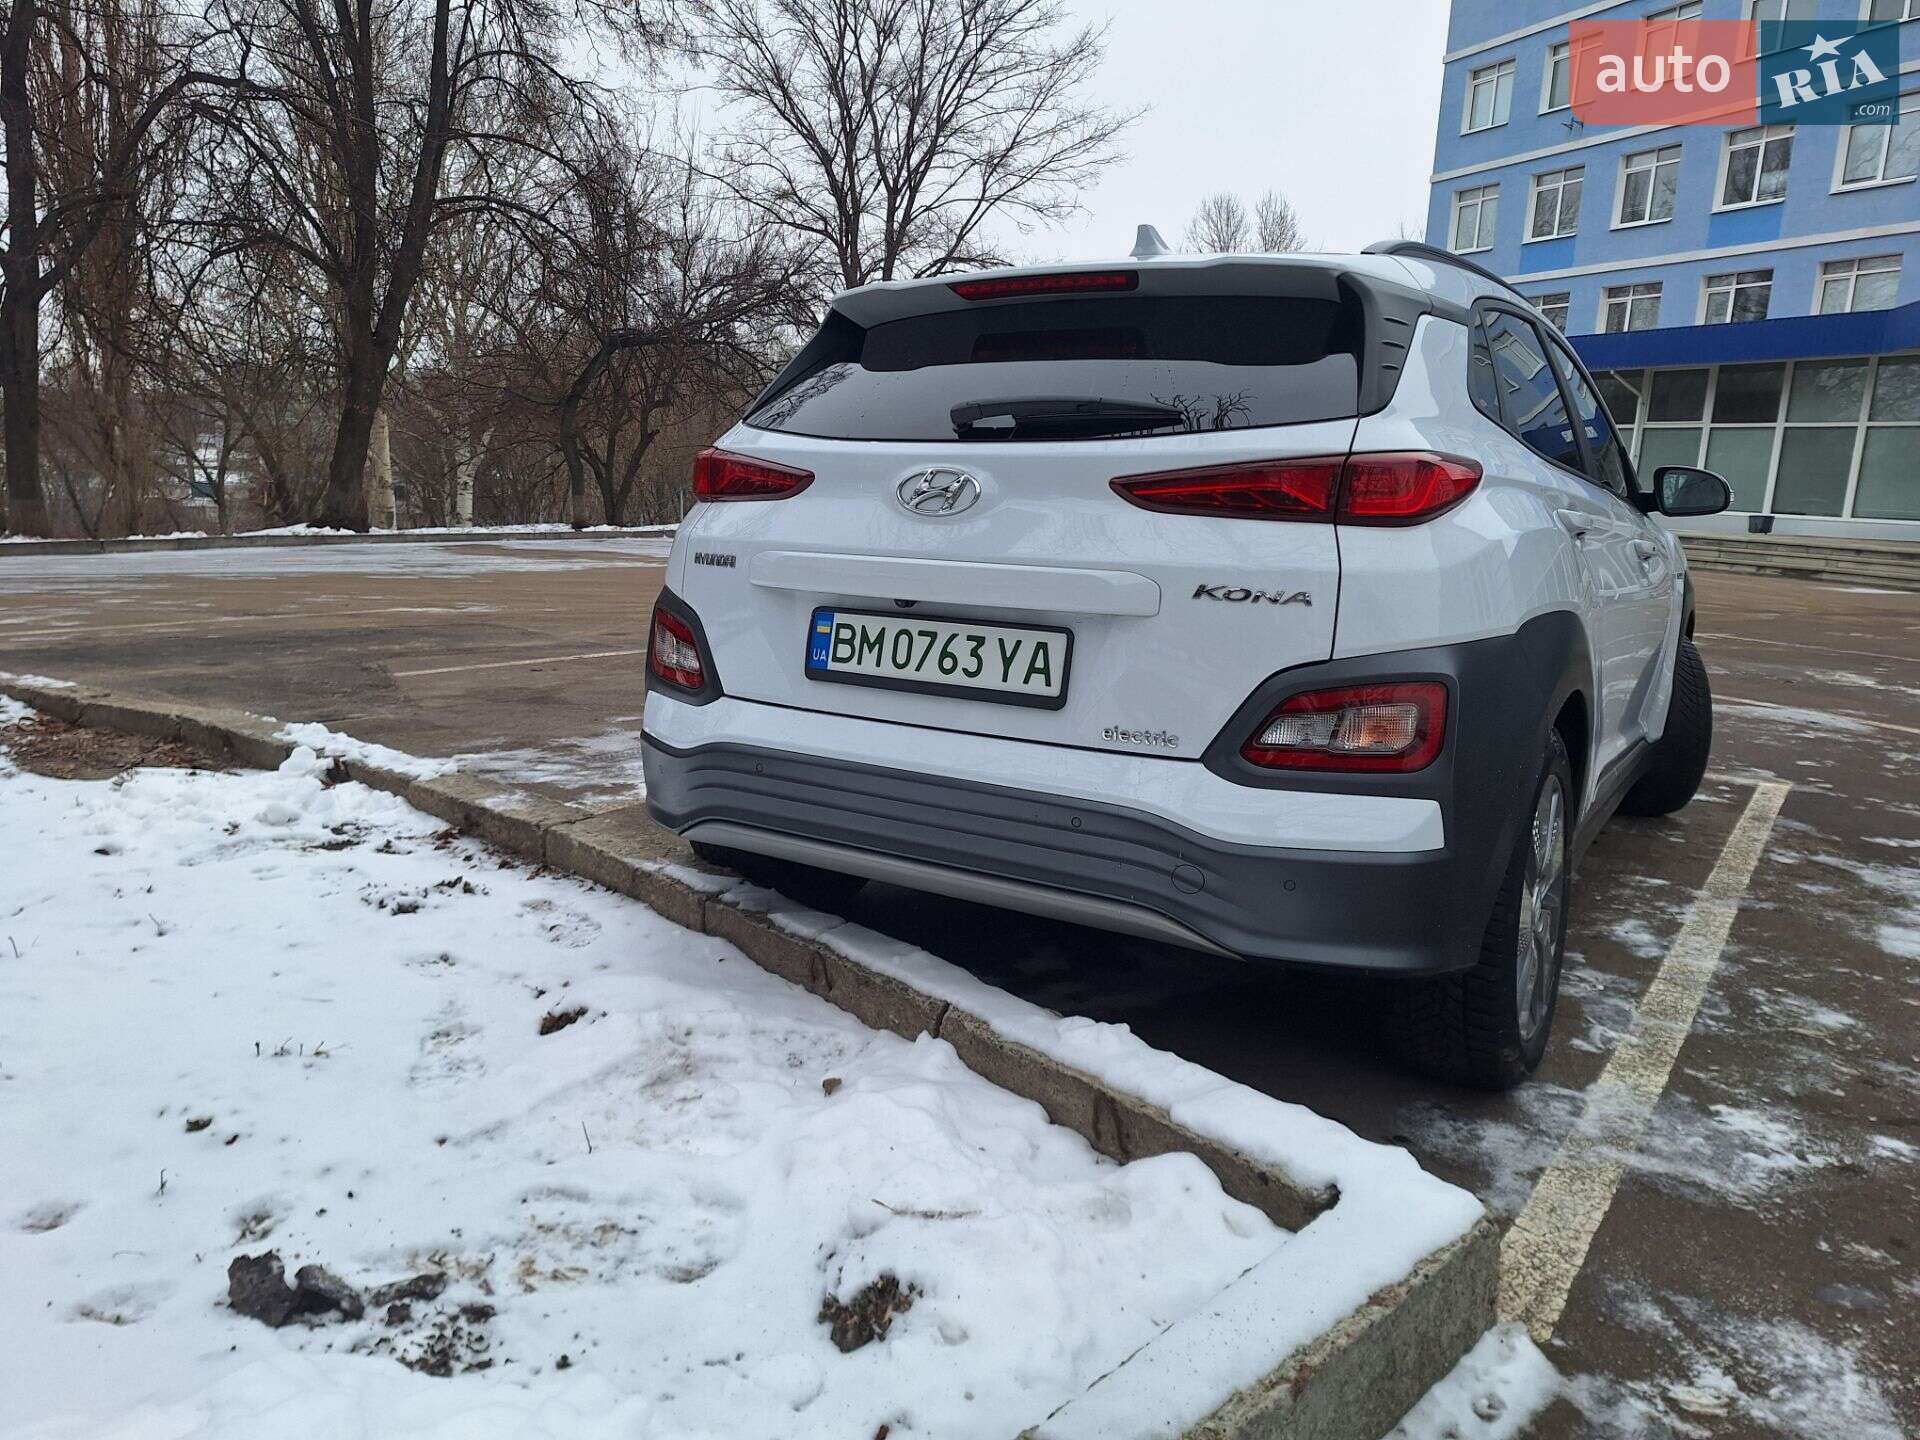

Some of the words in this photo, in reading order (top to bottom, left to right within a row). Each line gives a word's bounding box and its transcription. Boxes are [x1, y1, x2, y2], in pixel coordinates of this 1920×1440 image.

[1192, 584, 1313, 607] KONA
[812, 648, 827, 661] UA
[1102, 725, 1179, 748] electric
